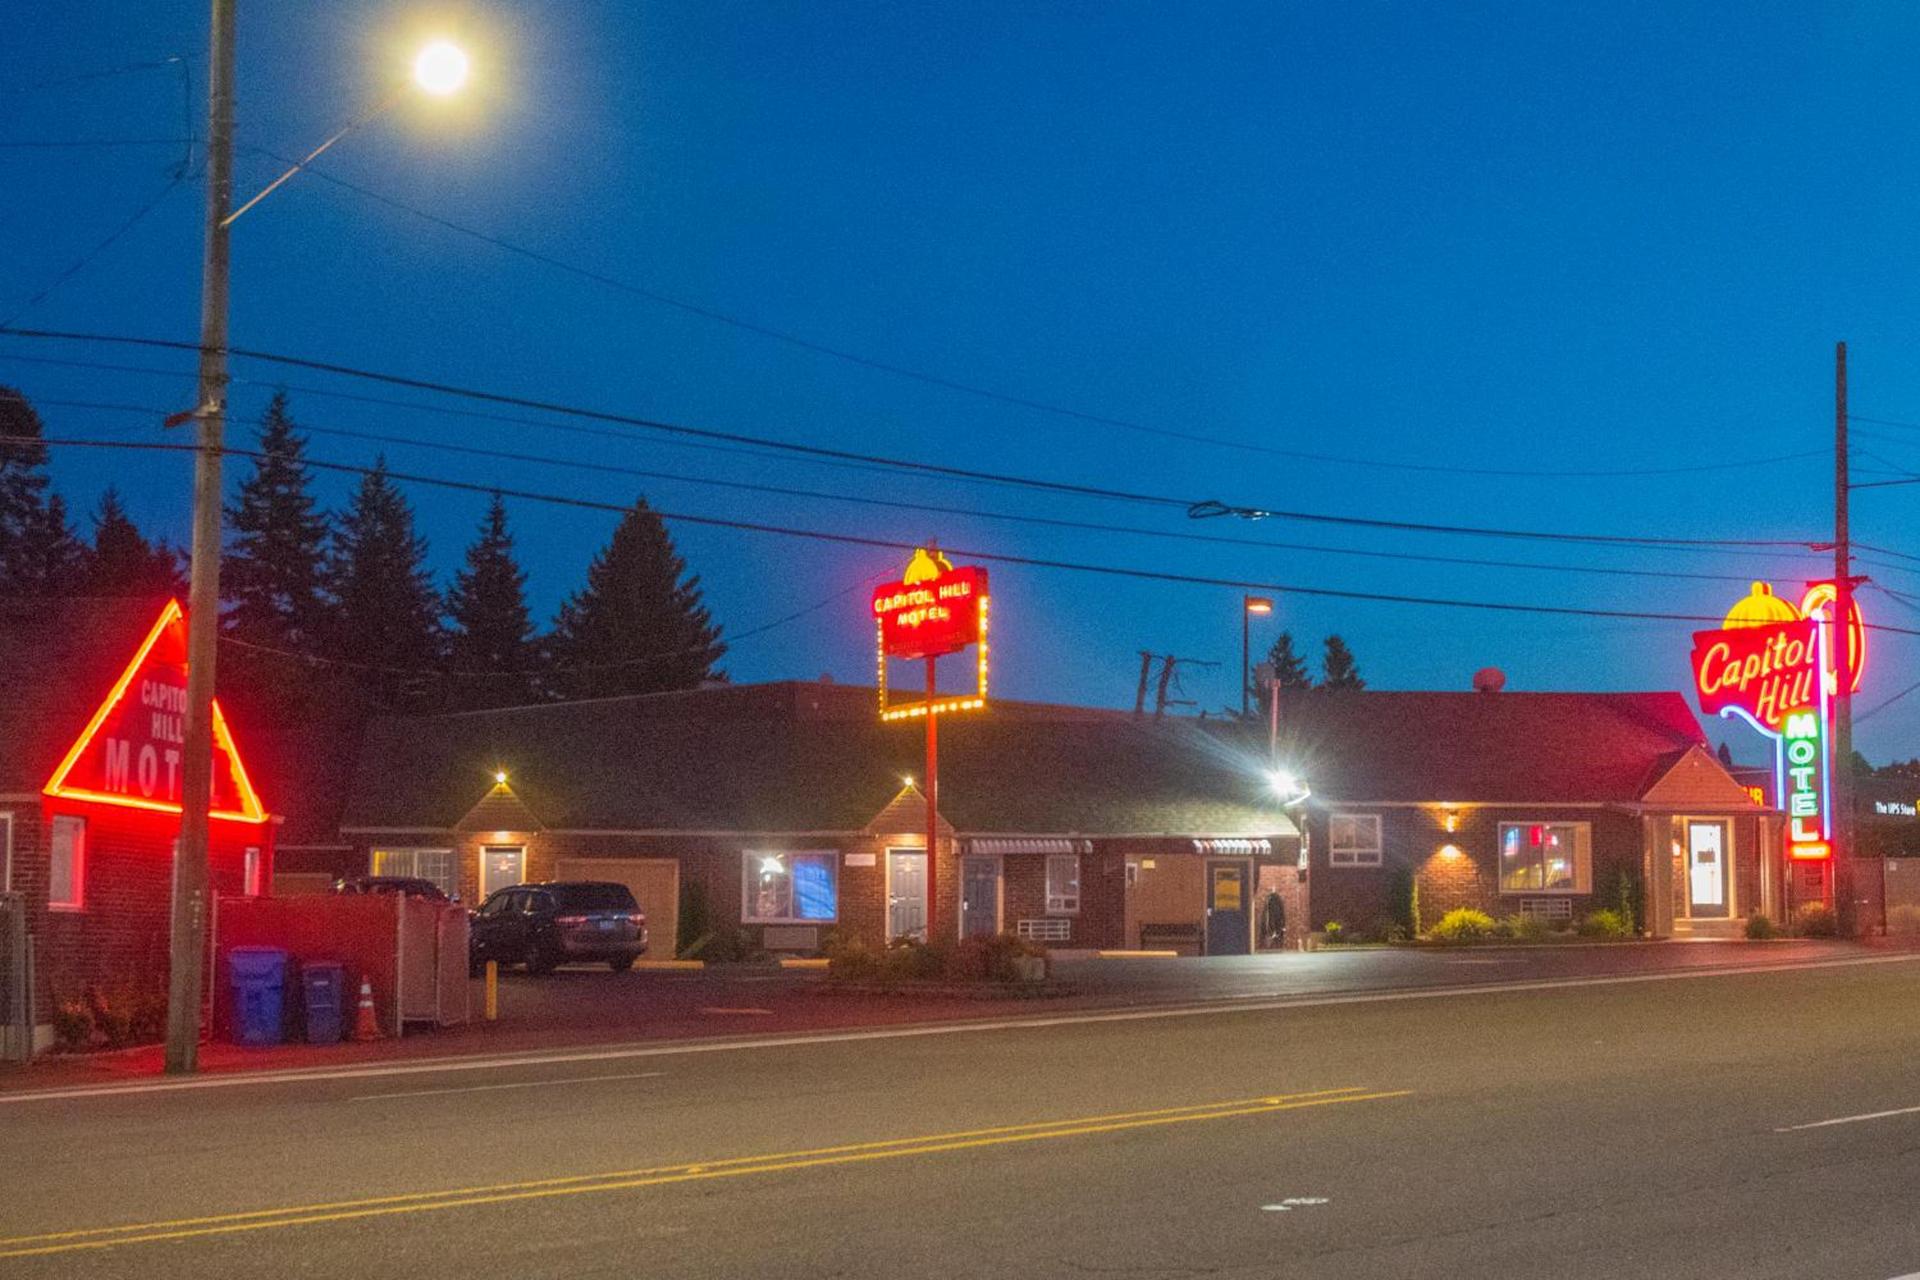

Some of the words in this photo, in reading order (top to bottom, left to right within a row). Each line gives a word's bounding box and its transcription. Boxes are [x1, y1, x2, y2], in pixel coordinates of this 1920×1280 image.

[874, 590, 935, 612] CAPITOL
[939, 581, 971, 600] HILL
[897, 606, 949, 627] MOTEL
[1699, 627, 1816, 694] Capitol
[141, 679, 187, 714] CAPITO
[1755, 668, 1813, 725] Hill
[152, 711, 184, 743] HILL
[1786, 713, 1819, 842] MOTEL
[1875, 801, 1888, 814] The
[1888, 802, 1900, 815] UPS
[1900, 803, 1916, 816] Store
